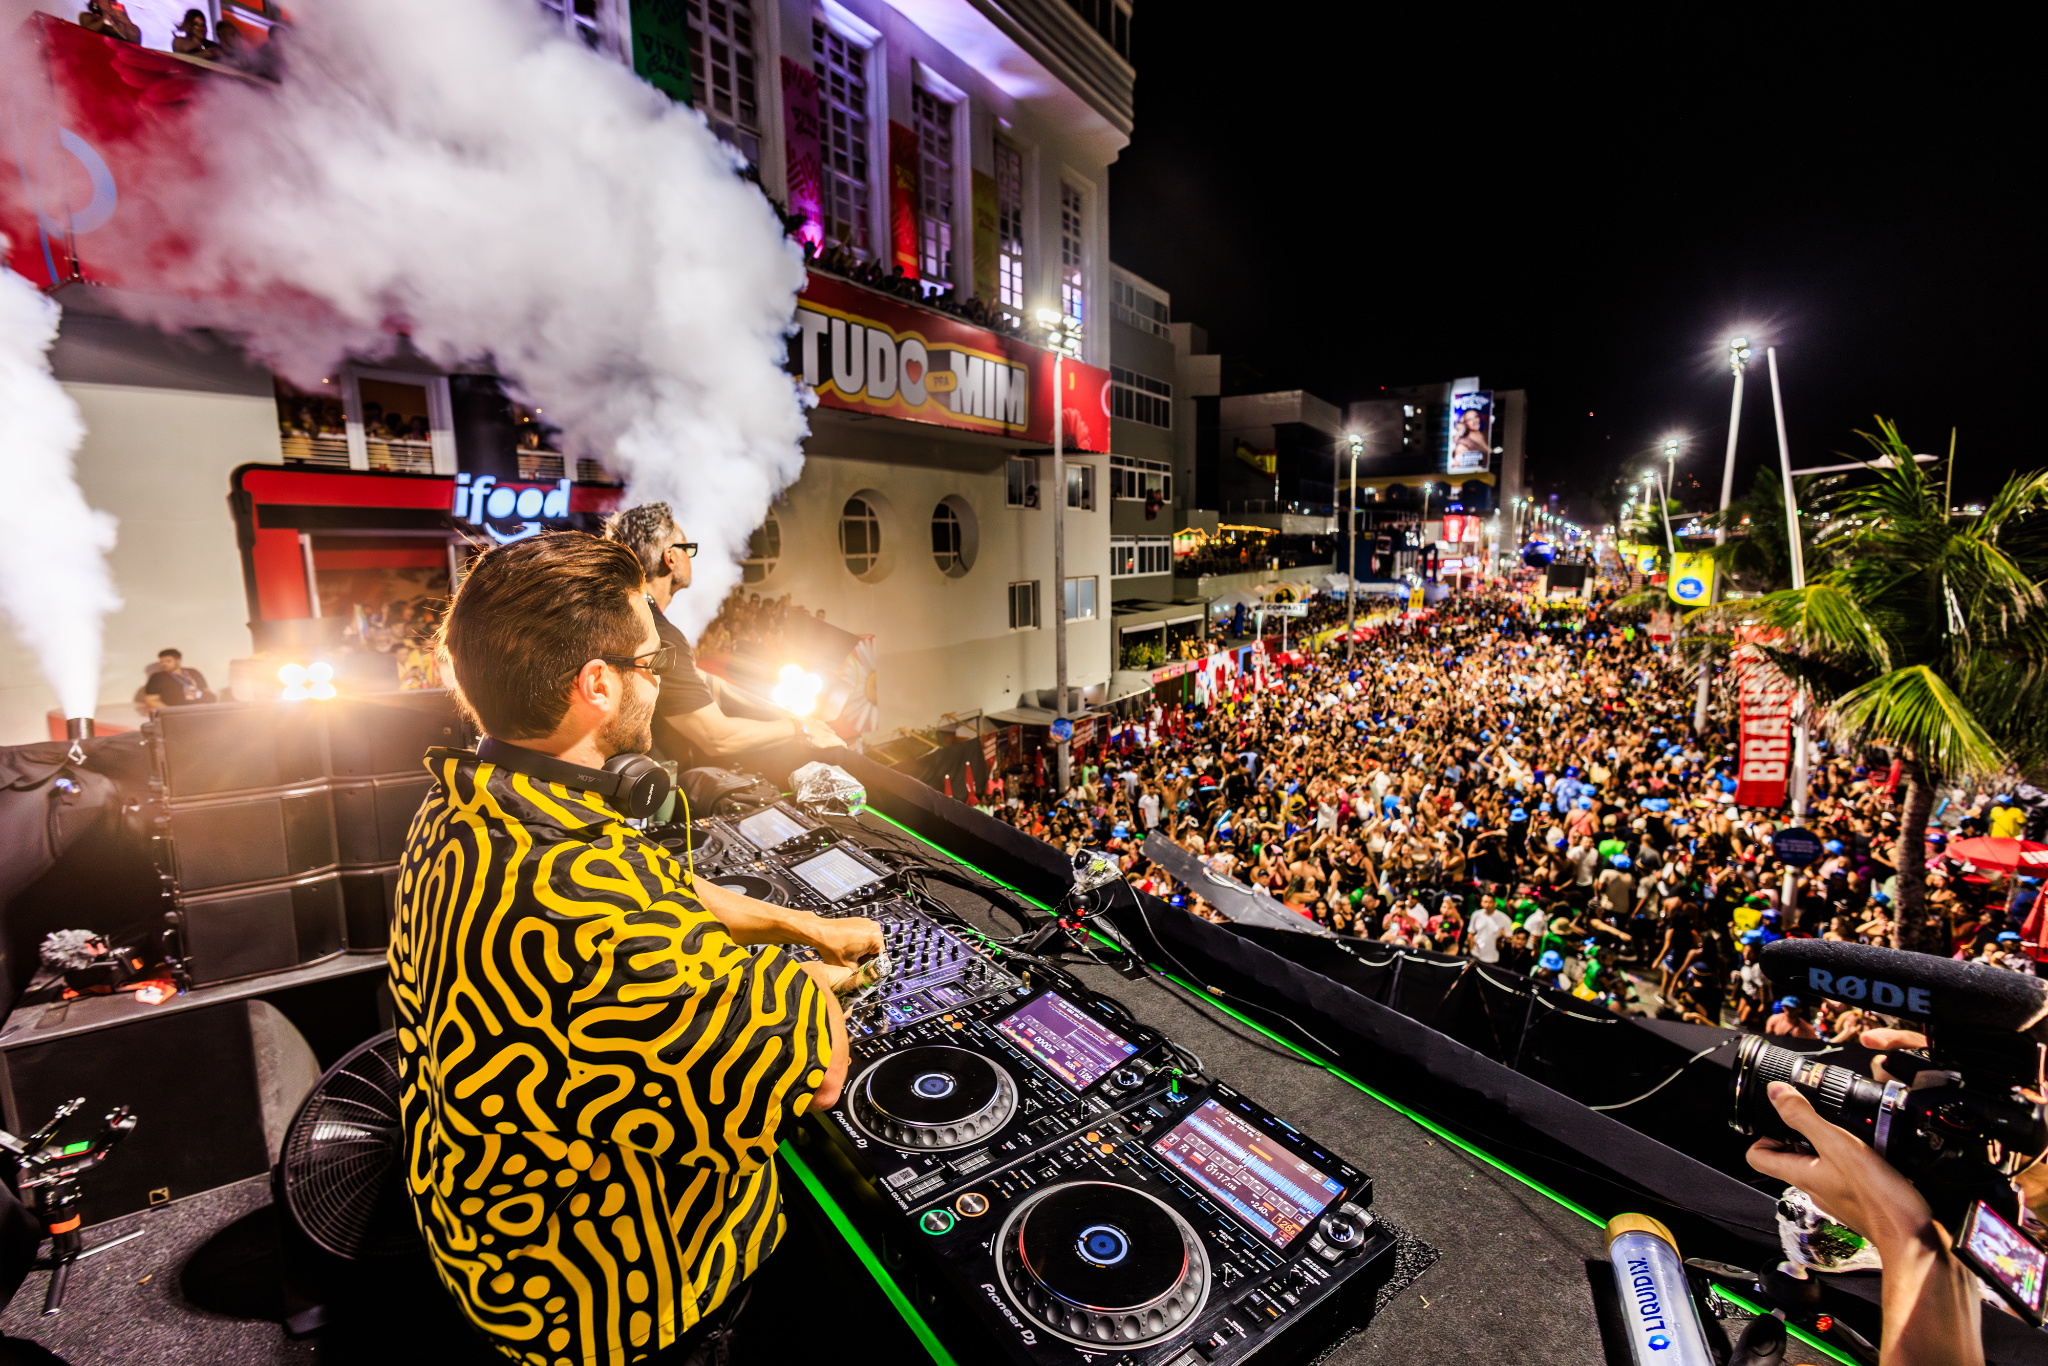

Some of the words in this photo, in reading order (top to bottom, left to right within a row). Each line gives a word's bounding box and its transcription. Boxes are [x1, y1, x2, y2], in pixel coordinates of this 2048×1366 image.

[950, 350, 1026, 427] MIM
[454, 472, 571, 526] ifood
[1808, 966, 1932, 1015] RØDE
[832, 1110, 860, 1140] Pioneer
[980, 1283, 1024, 1331] Pioneer
[1633, 1277, 1666, 1332] LIQUID
